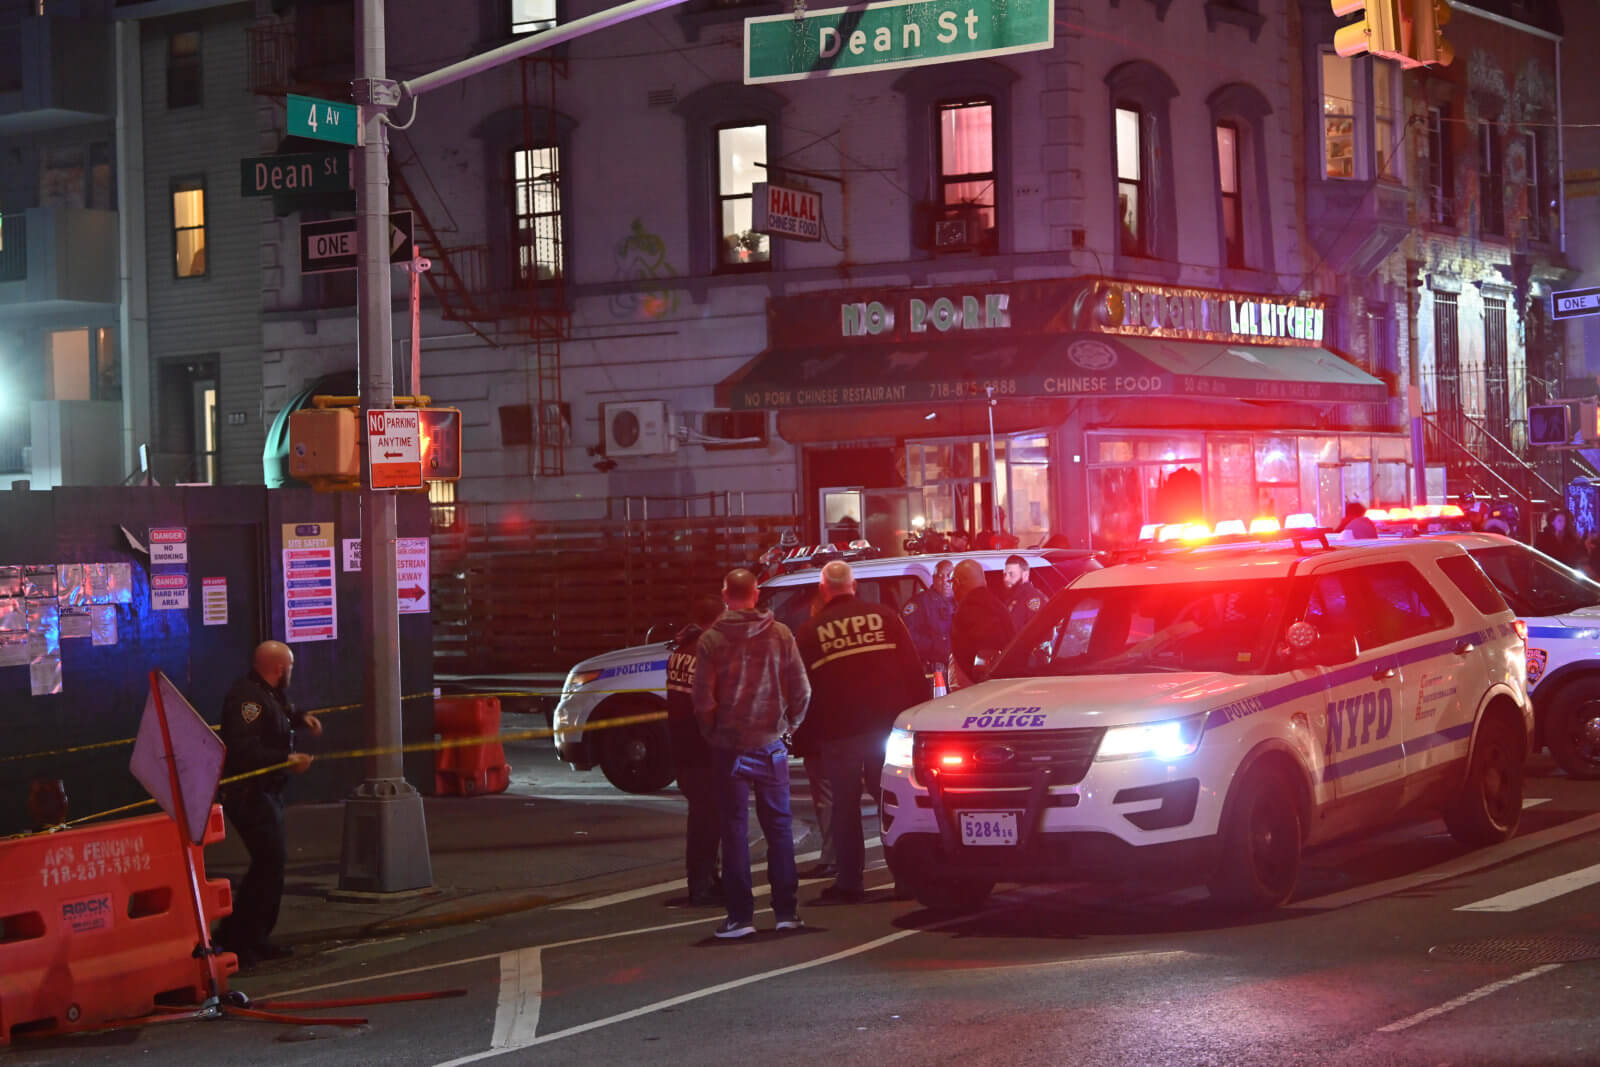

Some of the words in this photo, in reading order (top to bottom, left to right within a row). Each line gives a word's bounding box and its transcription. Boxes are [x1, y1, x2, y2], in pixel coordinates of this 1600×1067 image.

[819, 22, 921, 58] Dean
[937, 8, 979, 43] St
[307, 103, 318, 133] 4
[326, 106, 340, 126] Av
[255, 162, 313, 191] Dean
[324, 157, 337, 176] St
[770, 188, 817, 221] HALAL
[768, 214, 797, 232] CHINESE
[799, 220, 817, 236] FOOD
[317, 234, 349, 256] ONE
[1563, 297, 1587, 310] ONE
[841, 301, 893, 336] NO
[910, 293, 1011, 332] PORK
[1260, 303, 1324, 341] KITCHEN
[1043, 376, 1107, 393] CHINESE
[1115, 376, 1162, 392] FOOD
[744, 392, 761, 408] NO
[764, 391, 792, 406] PORK
[797, 389, 838, 405] CHINESE
[842, 385, 907, 402] RESTAURANT
[370, 414, 384, 433] NO
[387, 417, 416, 429] PARKING
[377, 436, 412, 448] ANYTIME
[153, 531, 183, 541] DANGER
[350, 542, 361, 551] POS
[397, 560, 426, 569] ESTRIAN
[155, 577, 184, 586] DANGER
[398, 573, 422, 581] LKWAY
[817, 613, 883, 642] NYPD
[821, 631, 886, 653] POLICE
[616, 661, 650, 676] POLICE
[669, 670, 696, 684] OLICE
[982, 706, 1041, 715] NYPD
[1225, 696, 1262, 720] POLICE
[961, 714, 1047, 729] POLICE
[1324, 687, 1392, 756] NYPD
[965, 821, 1001, 838] 5284
